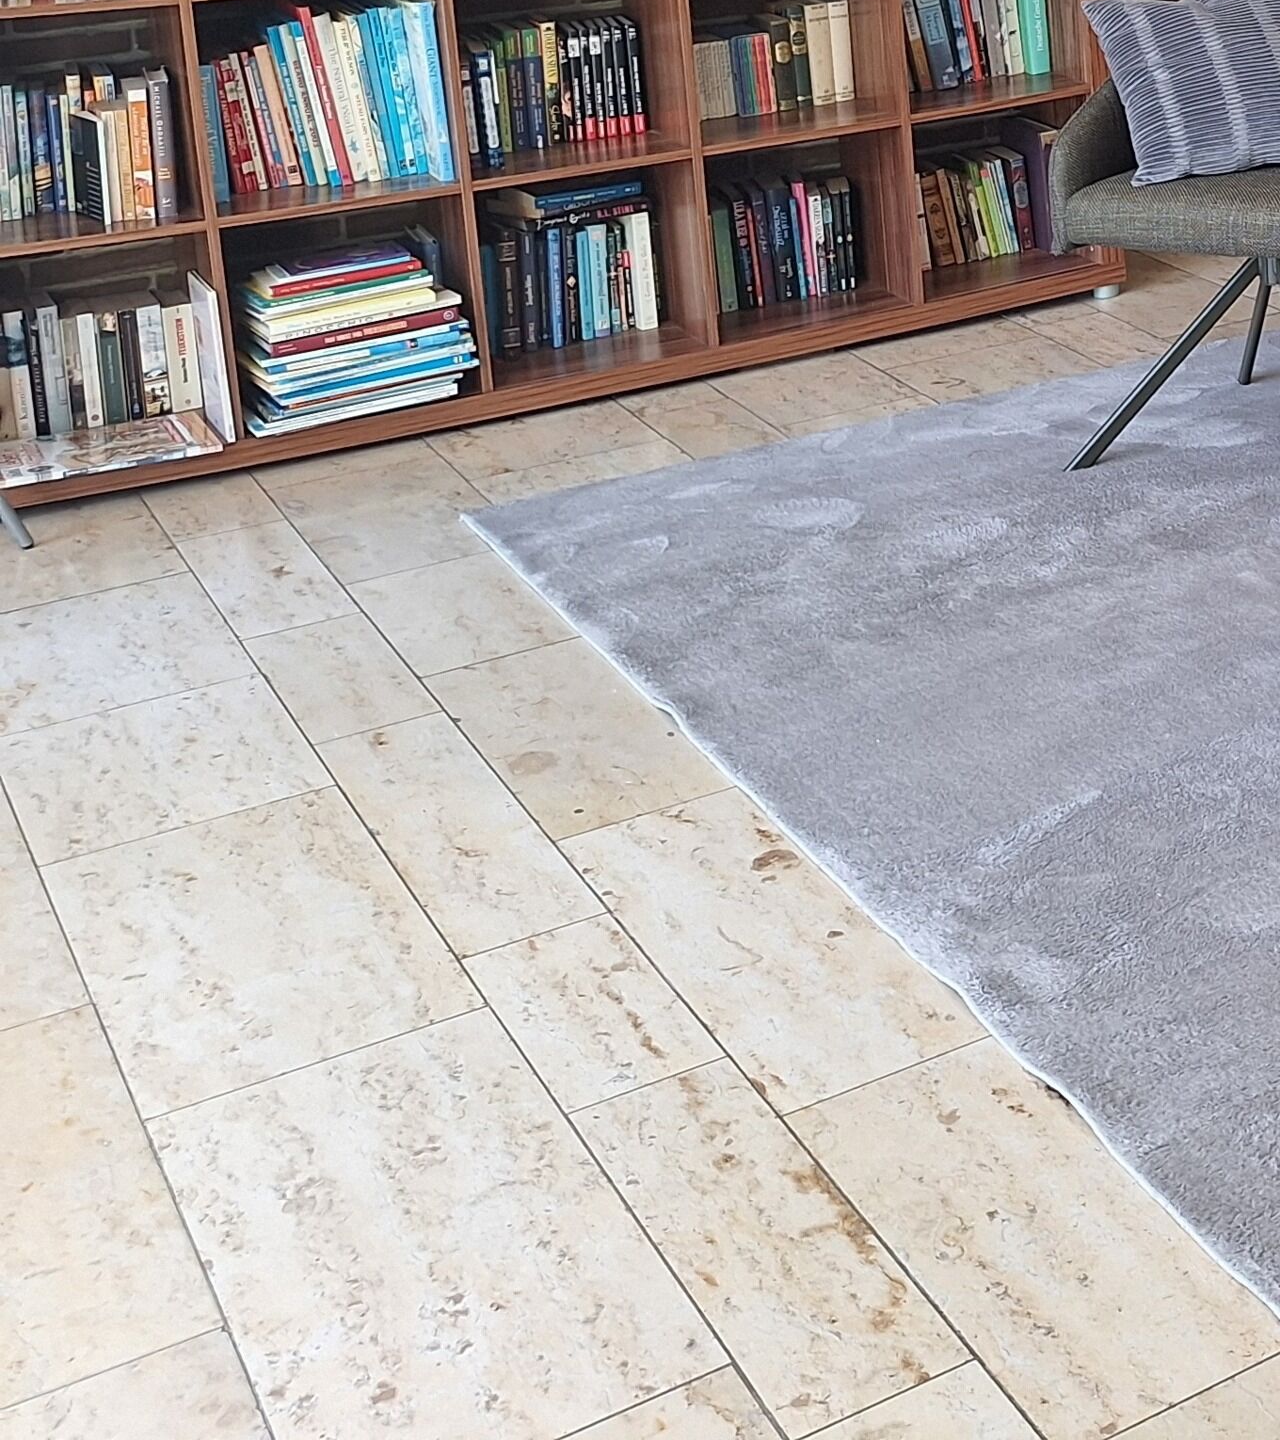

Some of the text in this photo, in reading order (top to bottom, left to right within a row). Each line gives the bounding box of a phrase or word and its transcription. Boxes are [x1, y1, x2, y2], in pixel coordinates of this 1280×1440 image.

[426, 47, 439, 79] GIANT
[332, 67, 348, 102] Natural
[340, 104, 355, 135] World
[284, 316, 374, 339] PINOCCHIO
